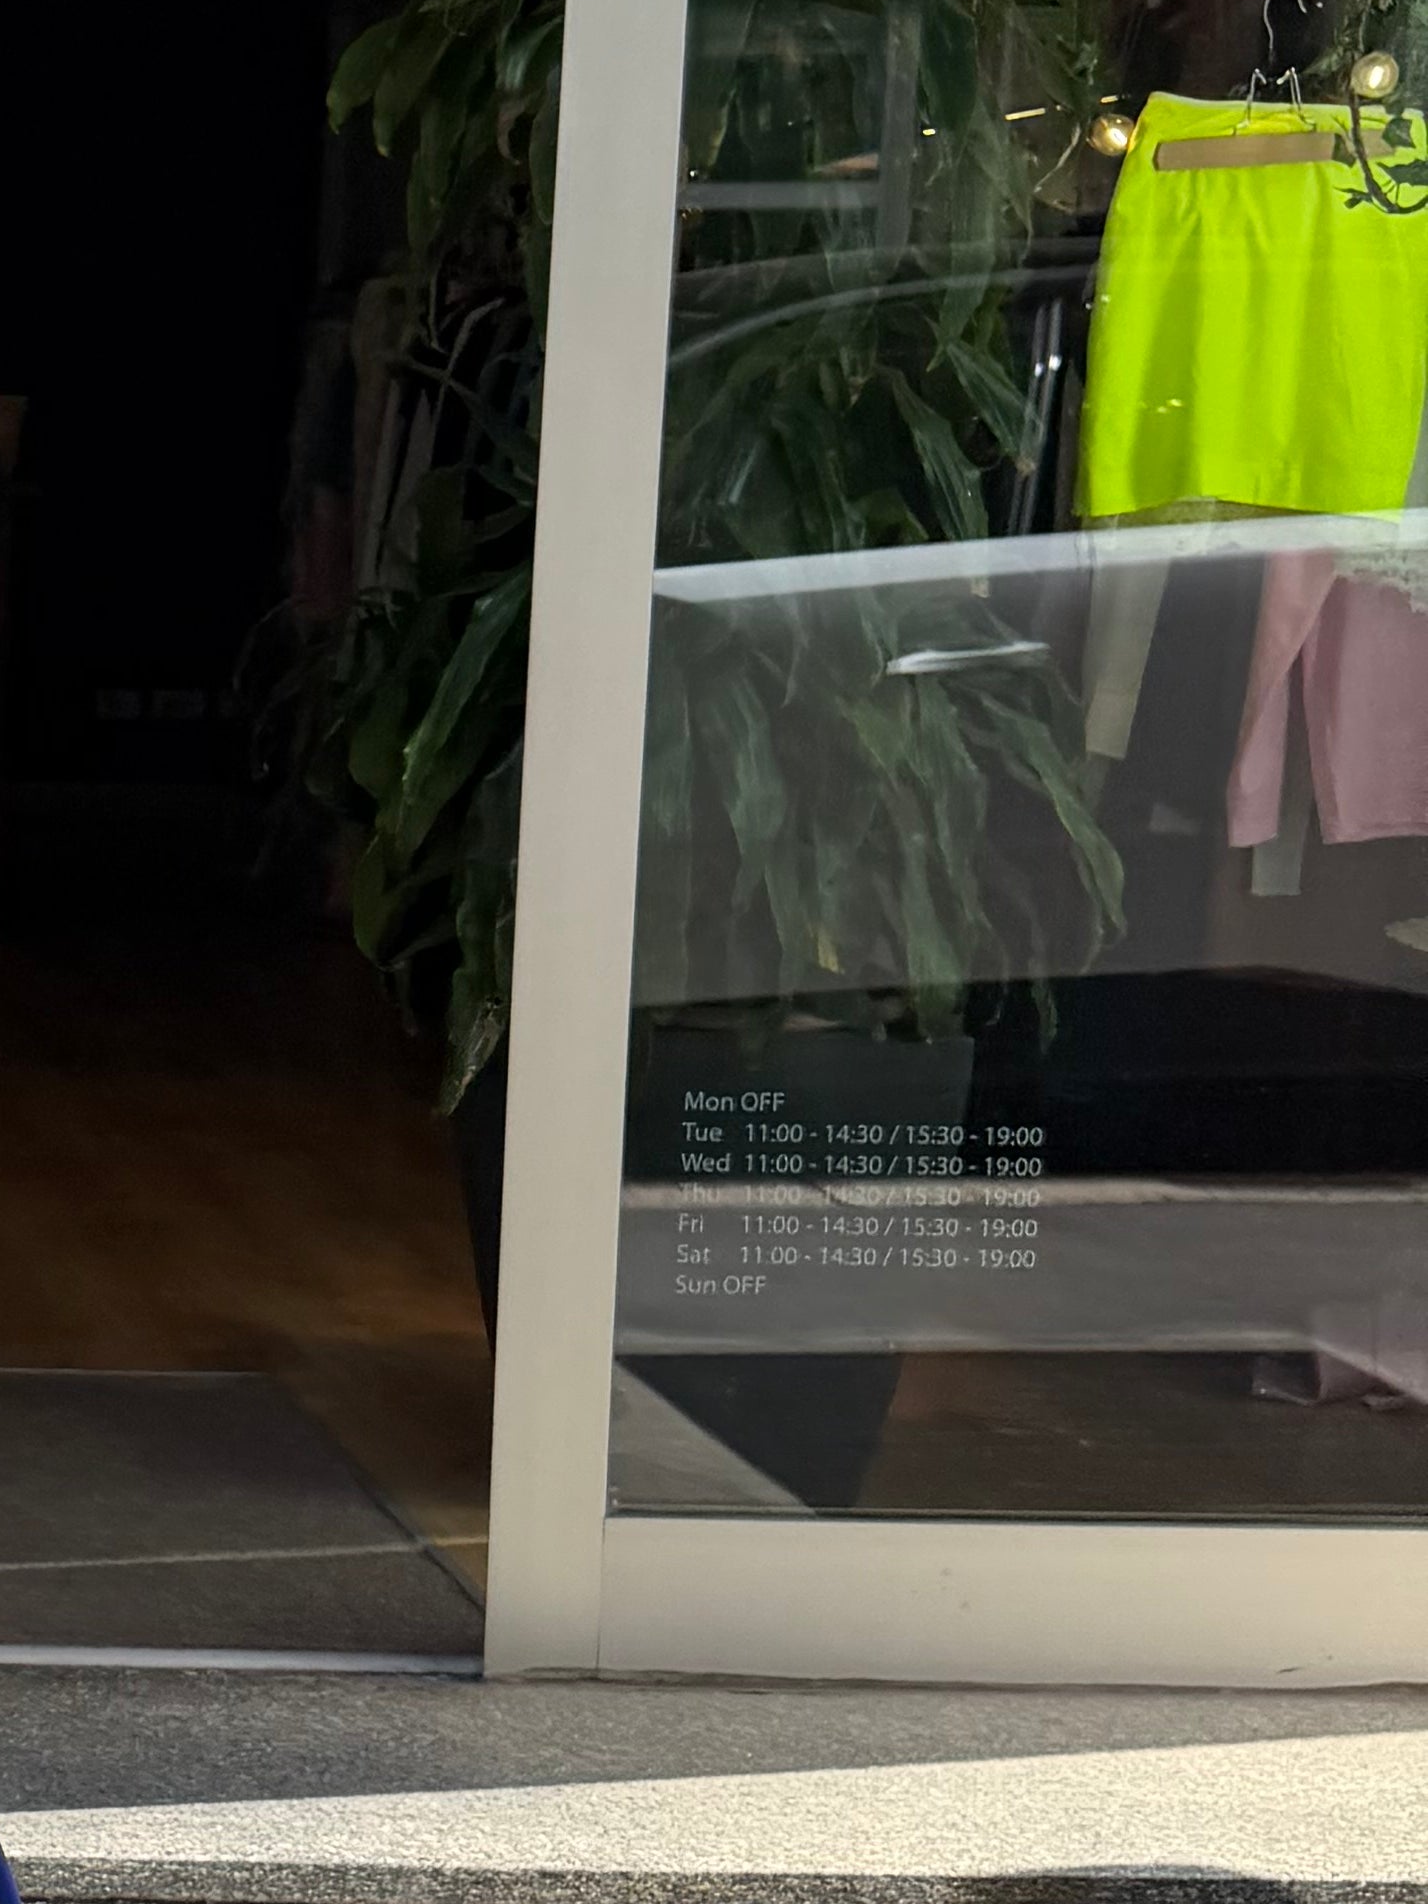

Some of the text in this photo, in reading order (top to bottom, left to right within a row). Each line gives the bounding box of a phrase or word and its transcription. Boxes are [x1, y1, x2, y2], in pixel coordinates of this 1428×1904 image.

[684, 1091, 785, 1112] Mon OFF
[682, 1121, 723, 1142] Tue
[746, 1123, 804, 1143] 11:00
[825, 1124, 883, 1145] 14:30
[907, 1125, 964, 1146] 15:30
[986, 1126, 1043, 1146] 19:00
[681, 1152, 732, 1173] Wed
[746, 1153, 803, 1174] 11:00
[824, 1154, 882, 1175] 14:30
[906, 1155, 963, 1176] 15:30
[985, 1156, 1042, 1177] 19:00
[678, 1213, 704, 1233] Fri
[742, 1215, 799, 1235] 11:00
[821, 1216, 879, 1236] 14:30
[903, 1217, 959, 1237] 15:30
[981, 1218, 1038, 1238] 19:00
[676, 1244, 711, 1264] Sat
[741, 1246, 797, 1265] 11:00
[821, 1246, 876, 1266] 14:30
[900, 1248, 957, 1268] 15:30
[979, 1249, 1036, 1269] 19:00
[676, 1275, 767, 1295] Sun OFF
